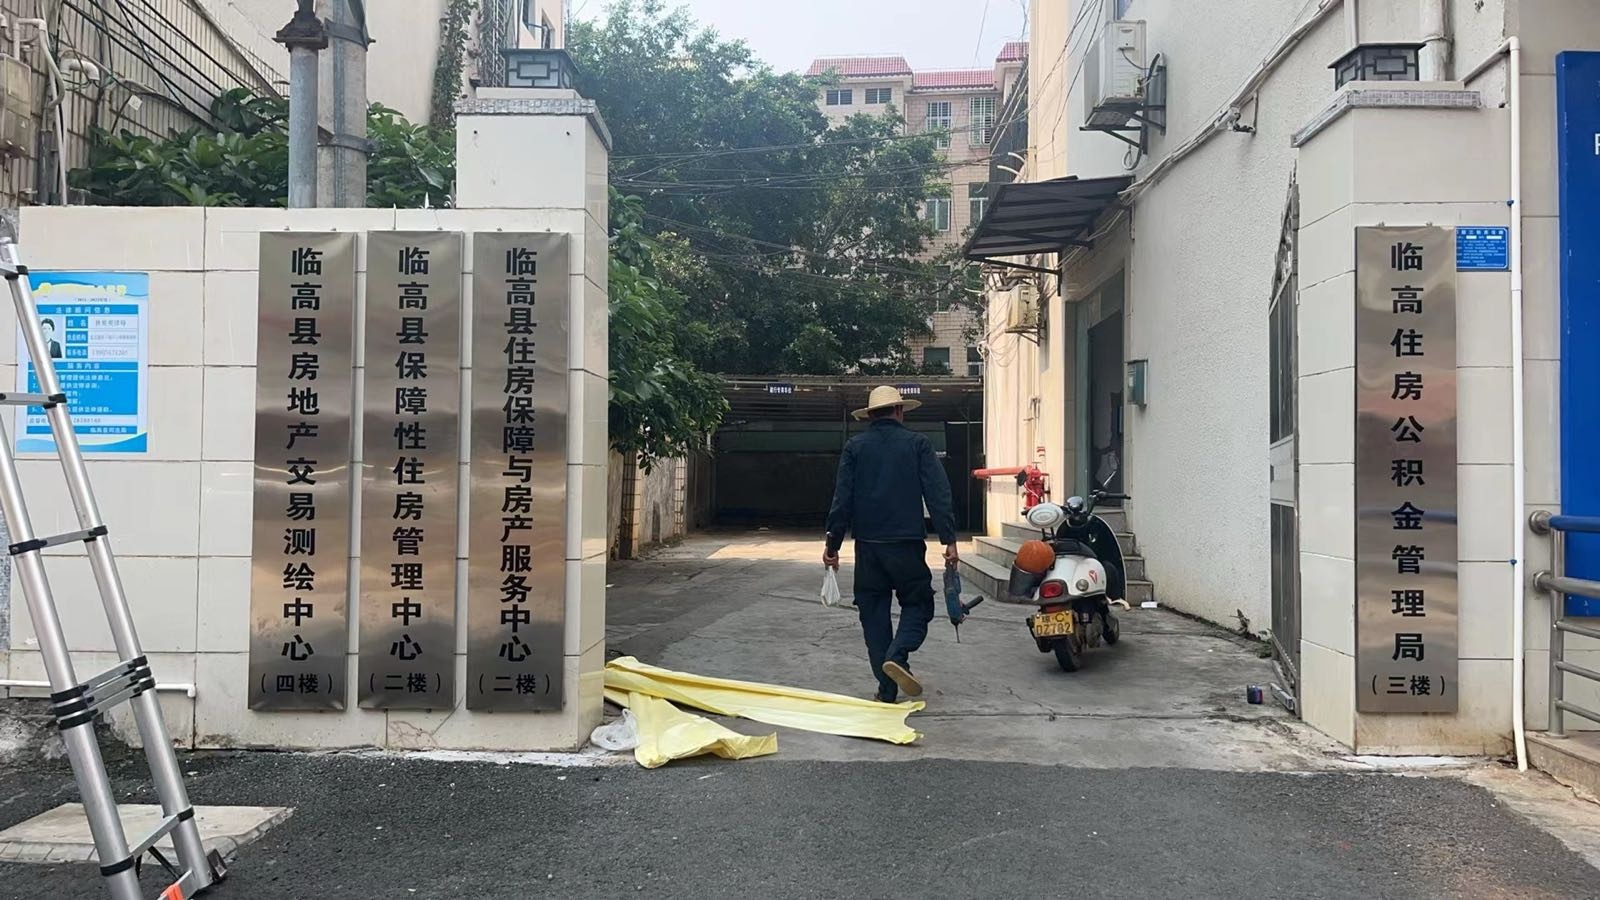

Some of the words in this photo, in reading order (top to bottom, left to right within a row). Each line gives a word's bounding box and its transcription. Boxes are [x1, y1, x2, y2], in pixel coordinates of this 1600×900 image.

[281, 247, 323, 662] 临高县房地产交易测绘中心
[390, 246, 430, 662] 临高县保障性住房管理中心
[499, 247, 537, 663] 临高县住房保障与房产服务中心
[1390, 242, 1426, 662] 临高住房公积金管理局
